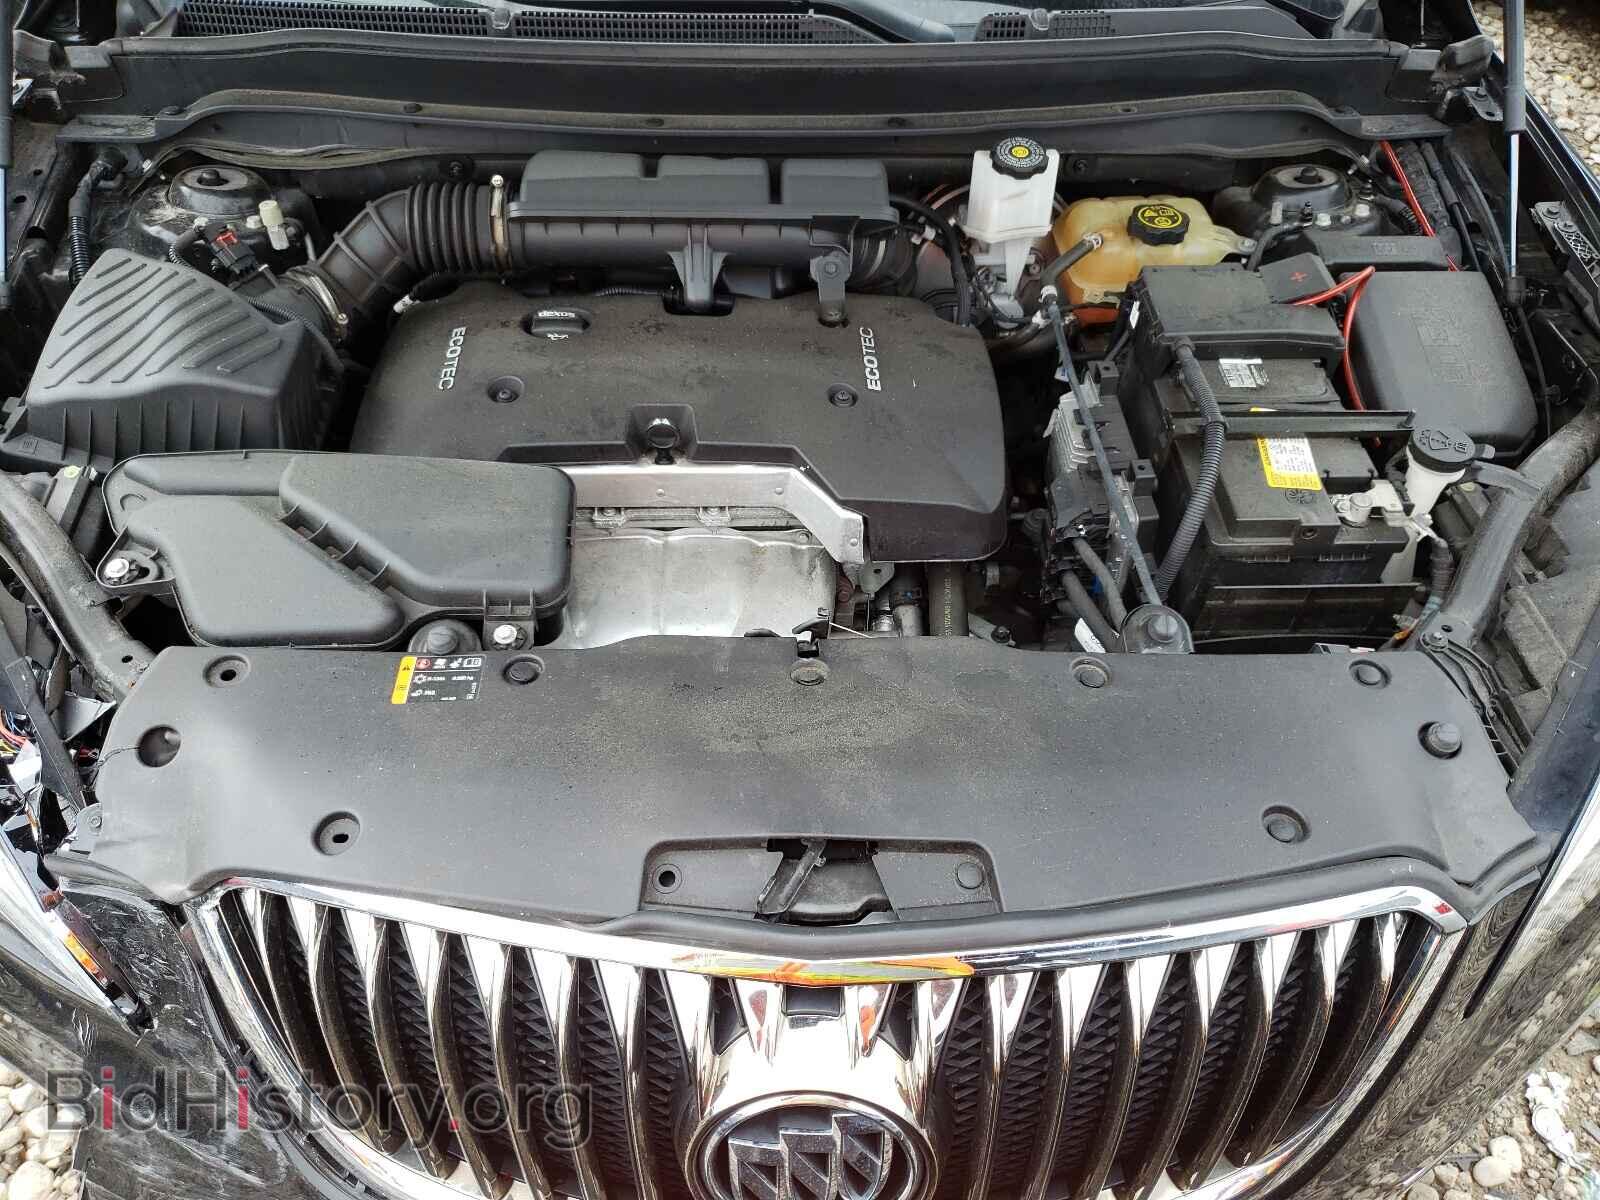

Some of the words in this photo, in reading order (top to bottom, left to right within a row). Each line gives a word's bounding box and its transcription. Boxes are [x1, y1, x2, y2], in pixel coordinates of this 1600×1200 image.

[538, 310, 576, 318] dexos
[438, 326, 467, 391] ECOTEC
[859, 327, 882, 391] ECOTEC
